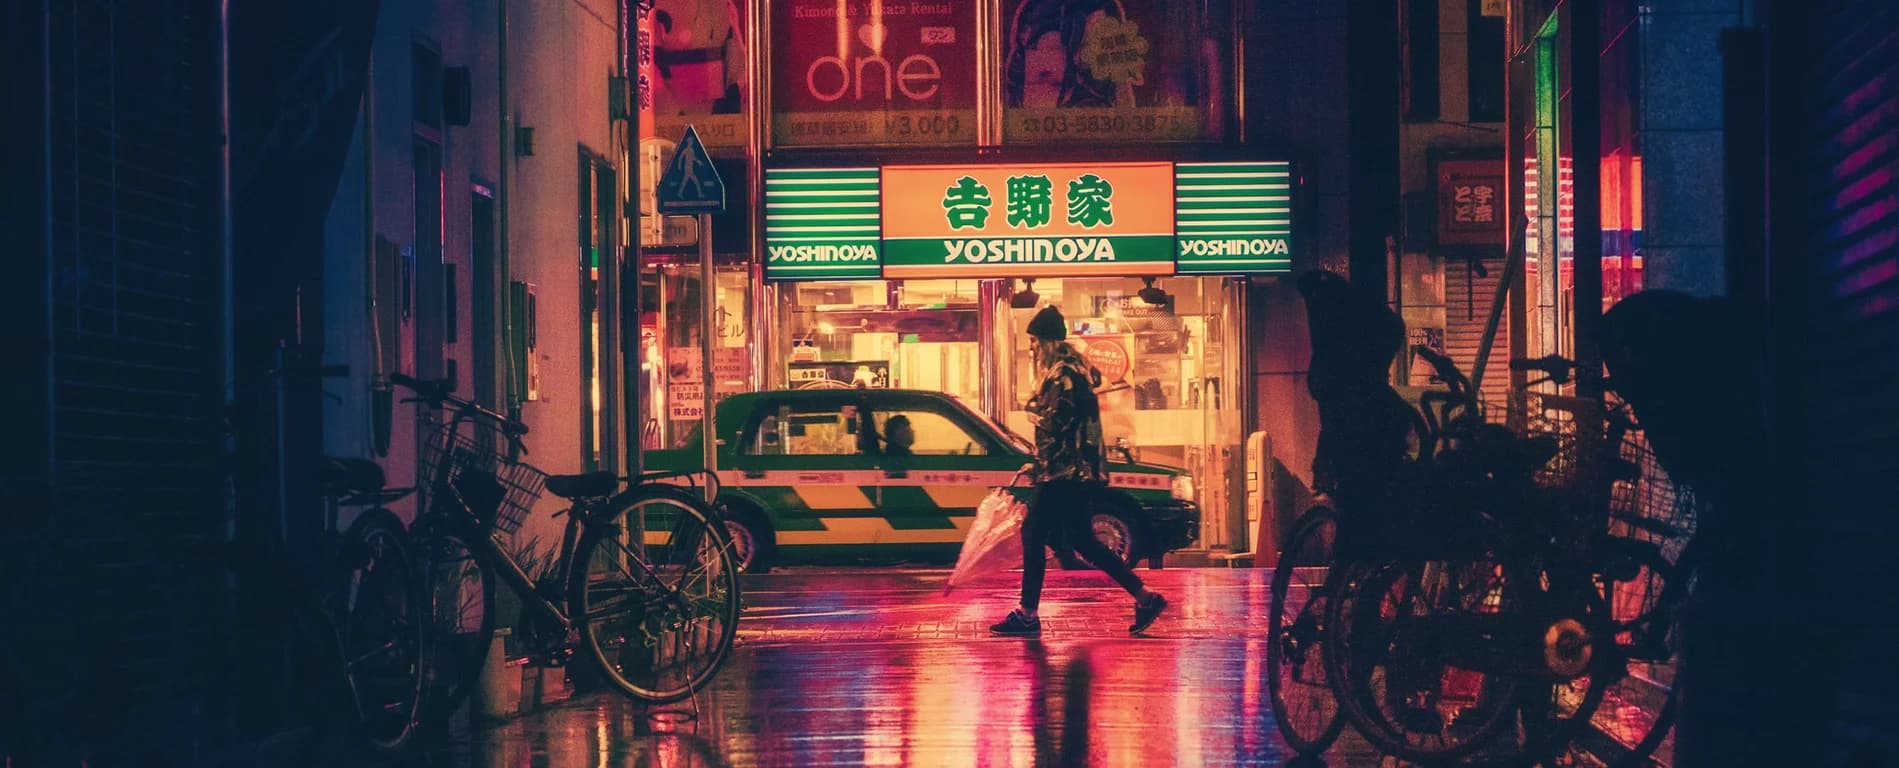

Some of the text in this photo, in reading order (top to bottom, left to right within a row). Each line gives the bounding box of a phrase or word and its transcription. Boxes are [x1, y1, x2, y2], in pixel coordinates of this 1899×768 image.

[864, 4, 906, 15] Yata
[912, 2, 952, 14] Rental
[806, 54, 941, 101] one
[942, 174, 1114, 230] 吉野家
[769, 245, 877, 262] YOSHINOYA
[944, 238, 1115, 263] YOSHINOYA
[1180, 239, 1289, 256] YOSHINOYA
